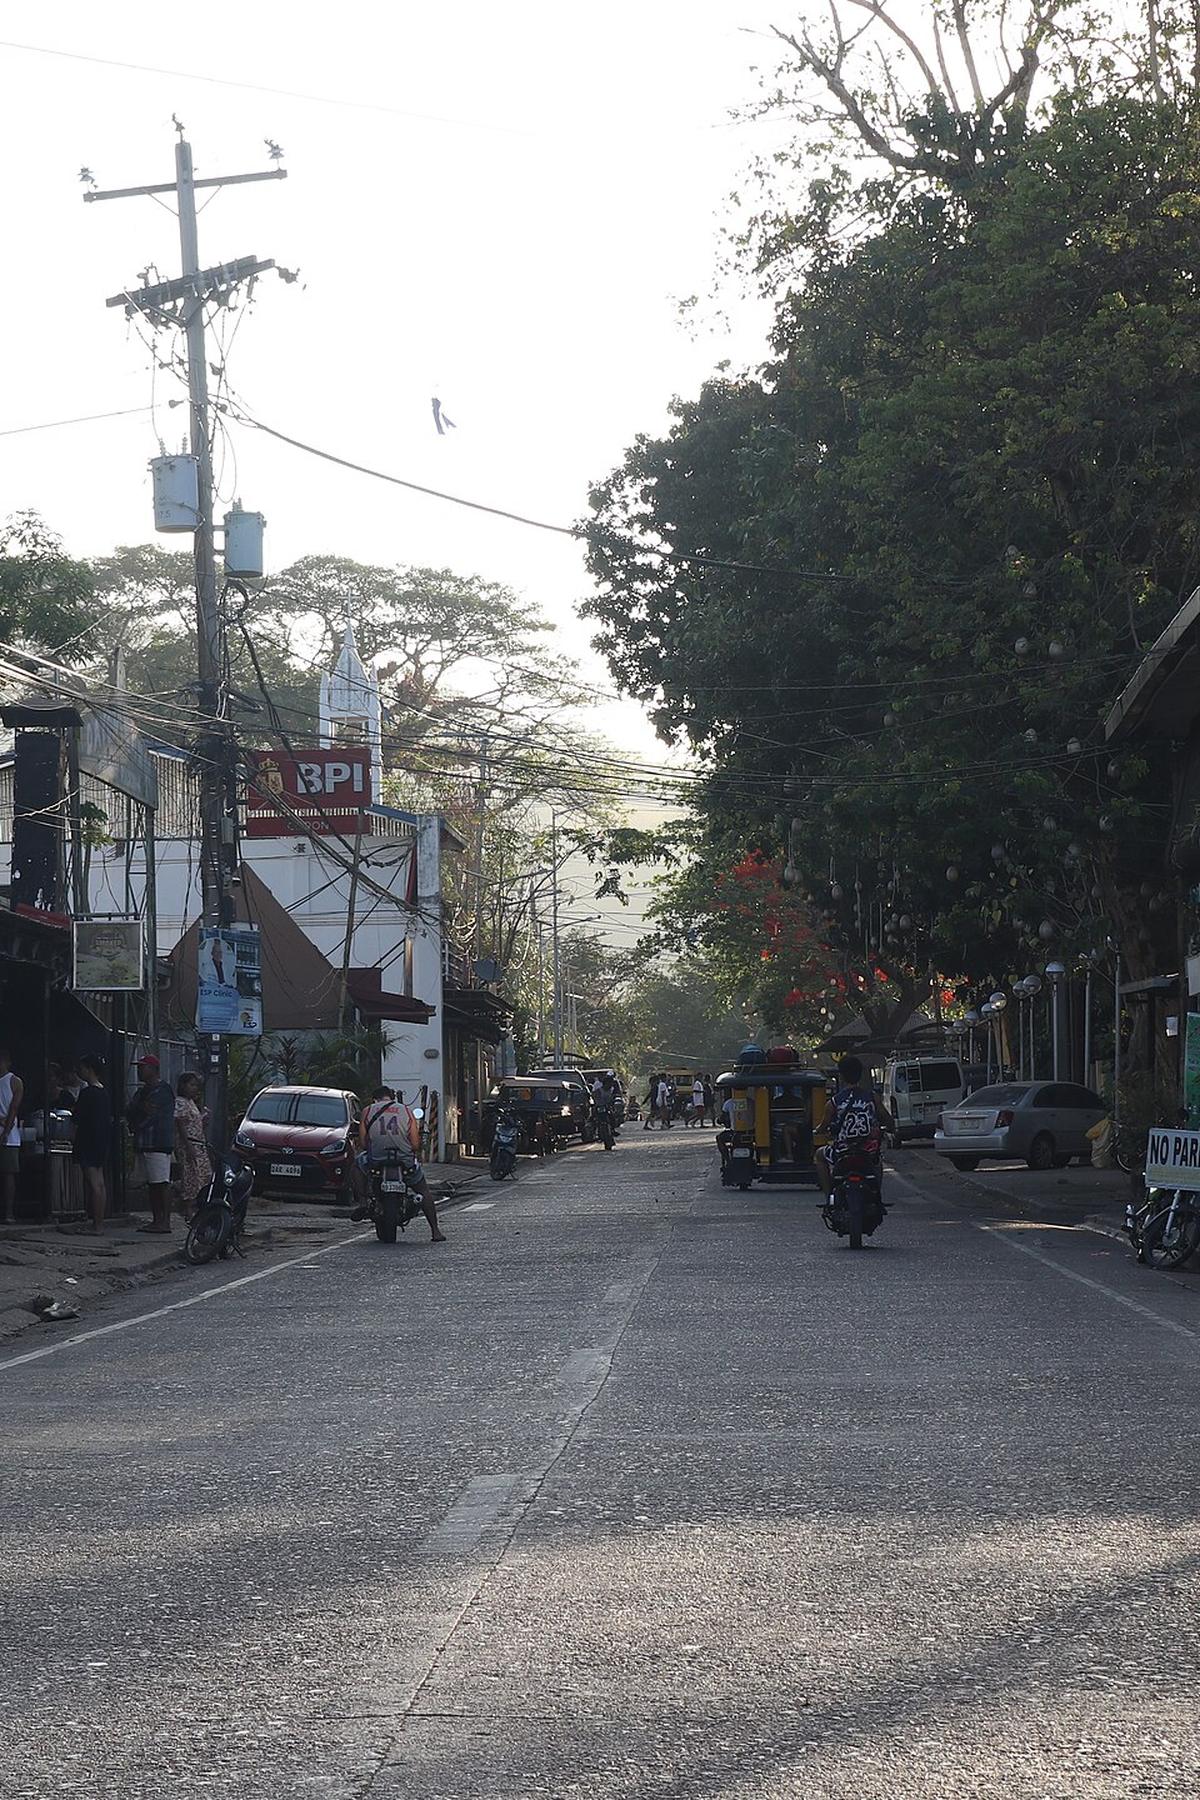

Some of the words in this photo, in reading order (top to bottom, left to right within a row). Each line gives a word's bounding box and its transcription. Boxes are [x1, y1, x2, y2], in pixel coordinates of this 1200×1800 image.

[297, 762, 363, 793] BPI
[380, 1116, 400, 1135] 14
[845, 1112, 870, 1138] 23
[1150, 1135, 1169, 1165] NO
[1172, 1136, 1200, 1168] PAR
